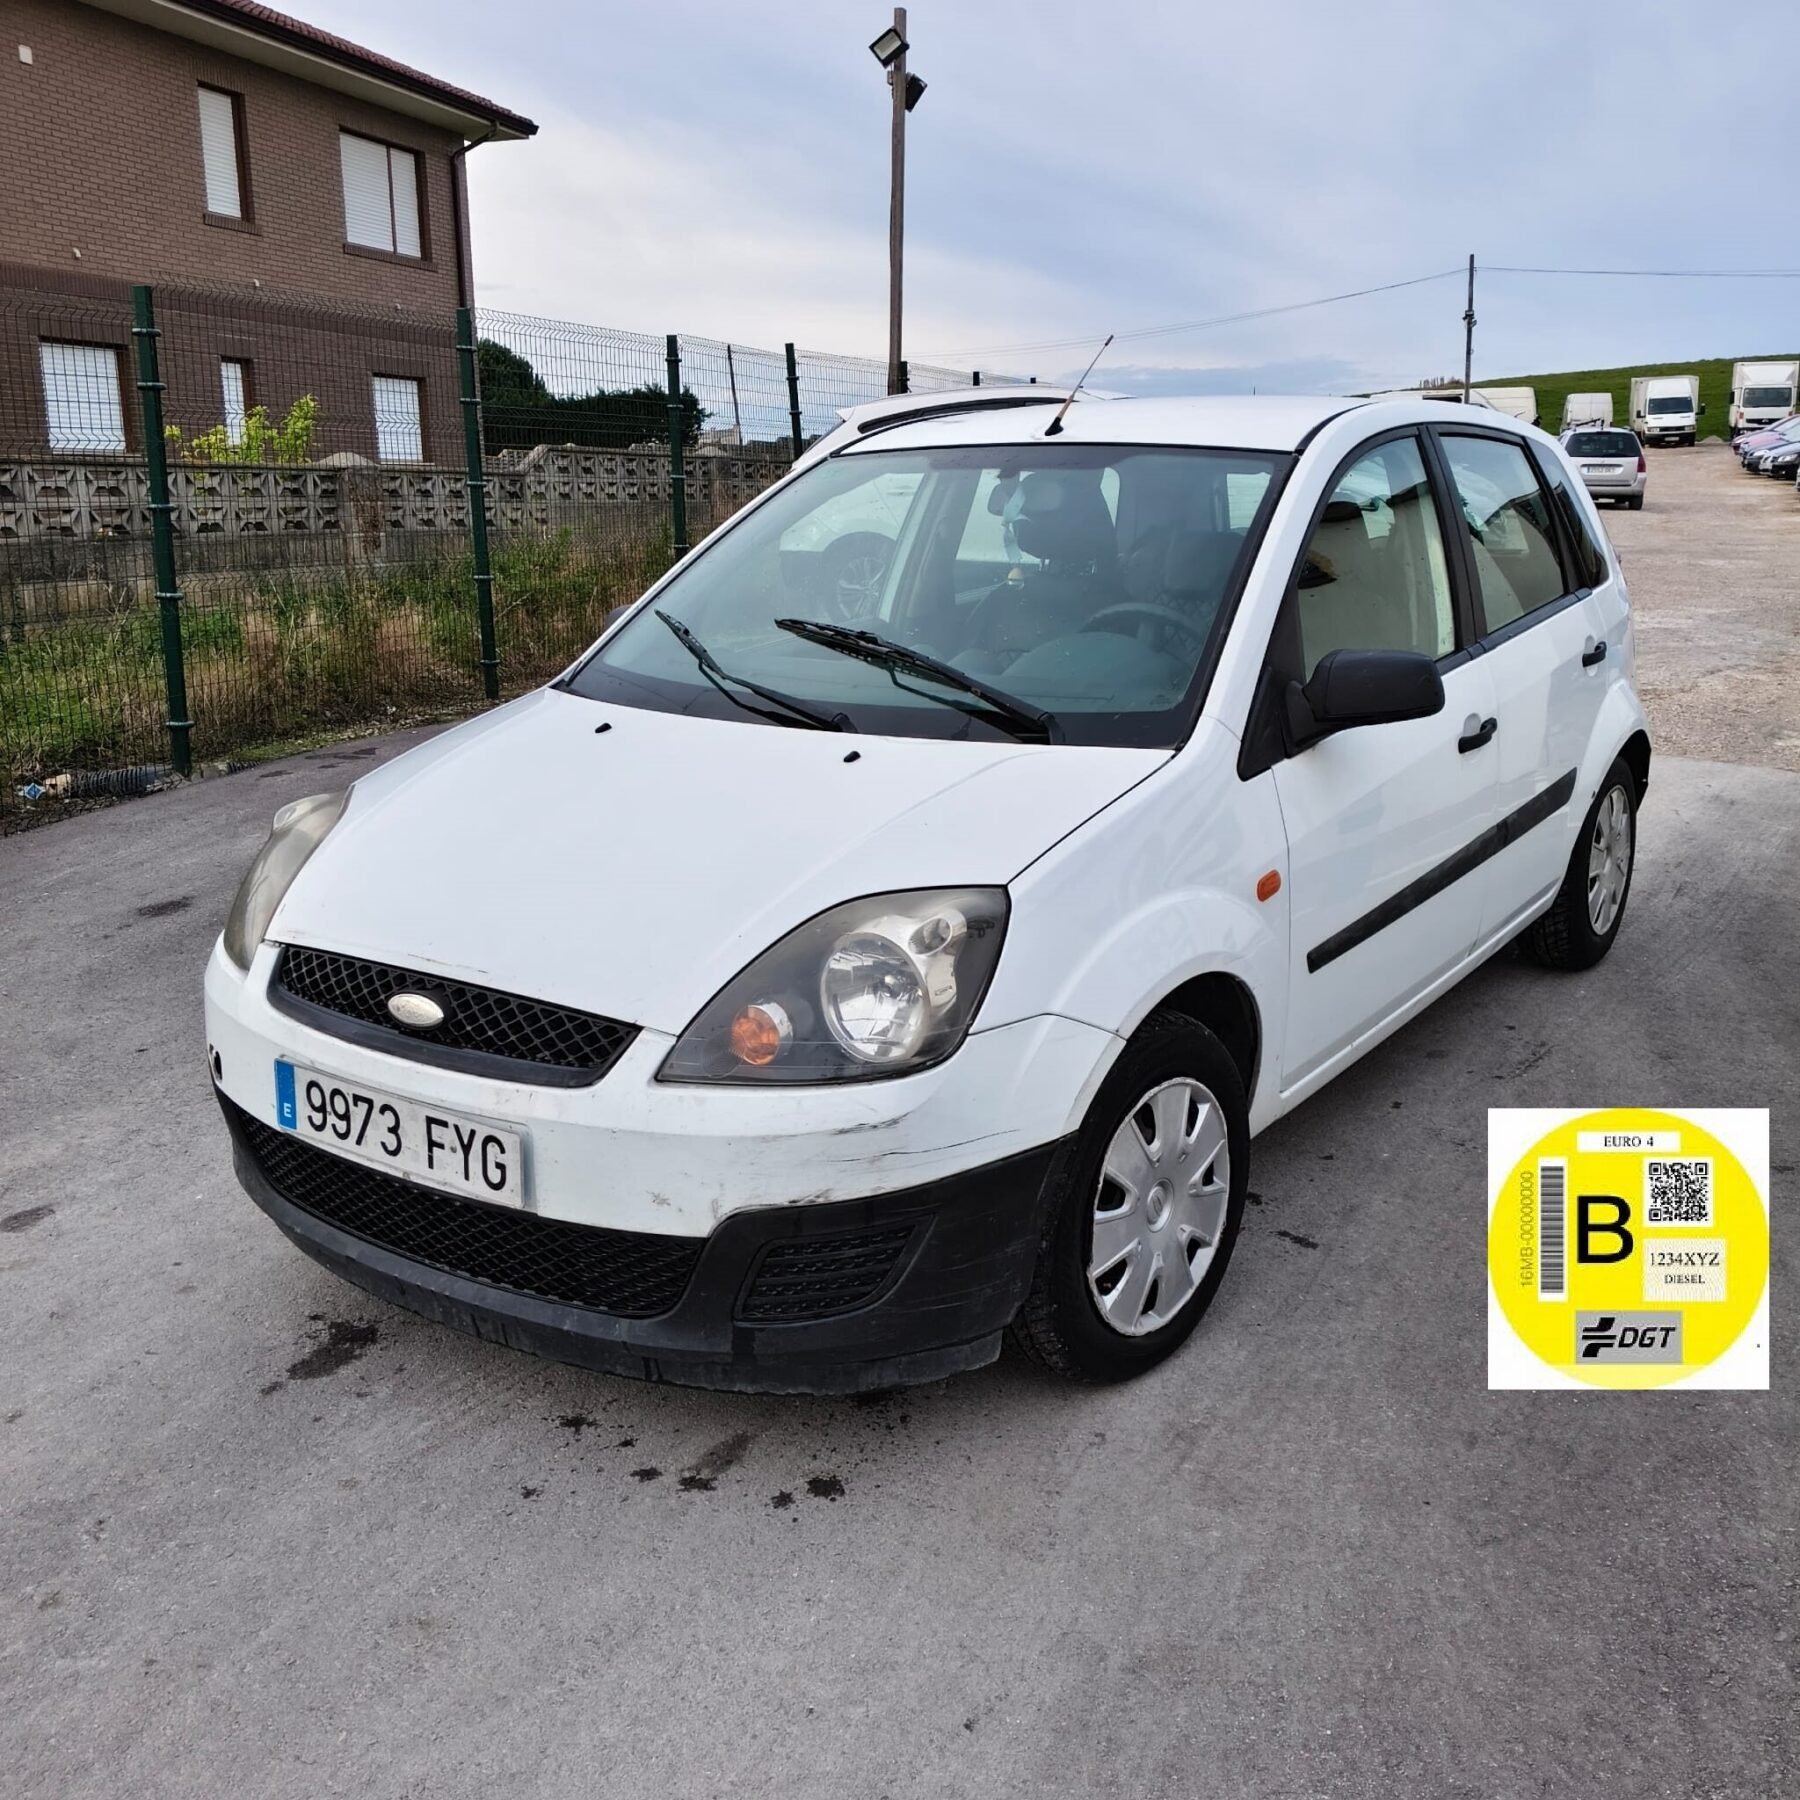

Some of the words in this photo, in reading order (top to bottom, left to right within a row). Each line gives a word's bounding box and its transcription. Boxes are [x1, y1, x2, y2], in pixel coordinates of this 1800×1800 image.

[283, 1102, 293, 1118] E
[305, 1080, 402, 1157] 9973
[425, 1115, 507, 1191] FYG
